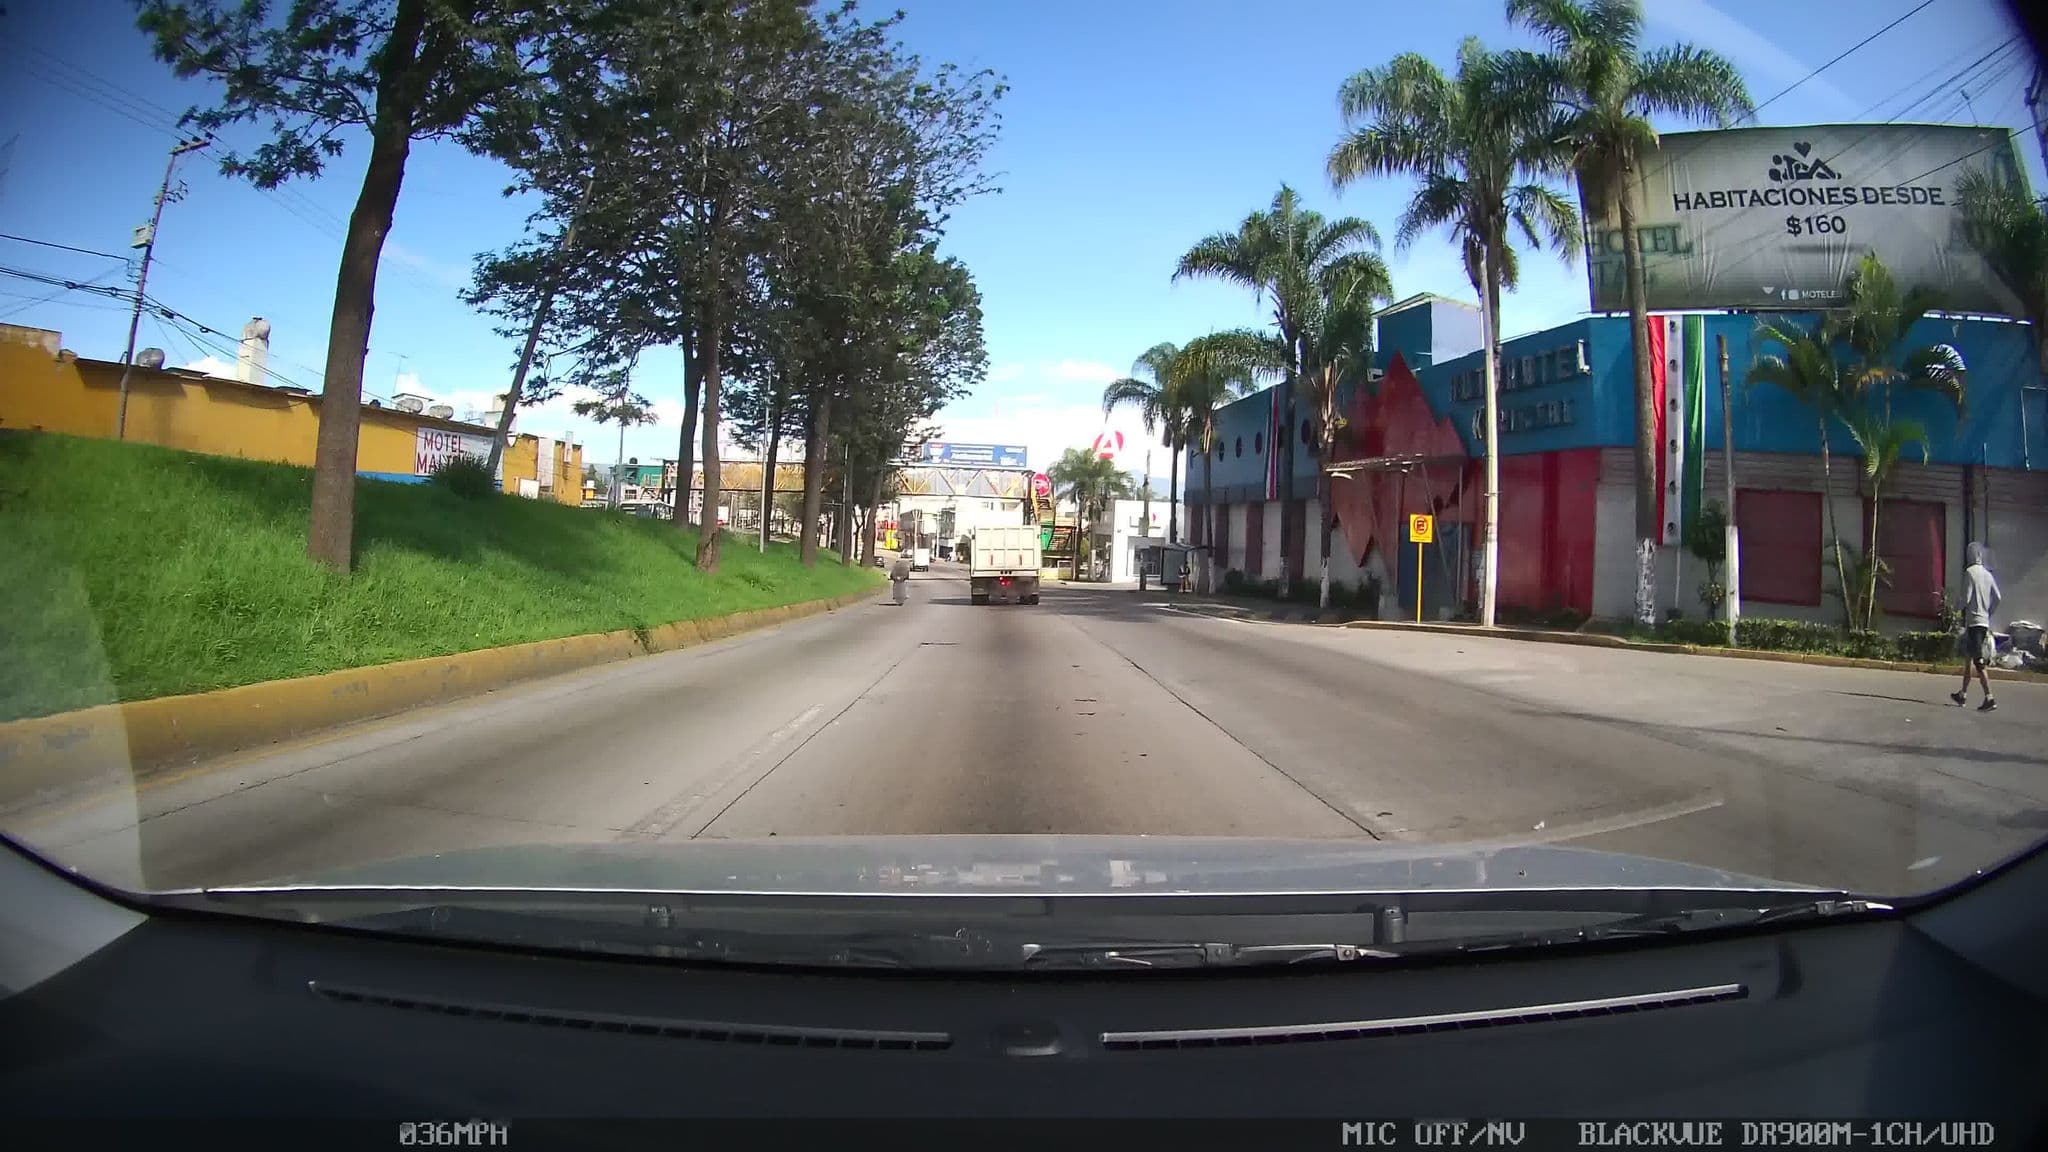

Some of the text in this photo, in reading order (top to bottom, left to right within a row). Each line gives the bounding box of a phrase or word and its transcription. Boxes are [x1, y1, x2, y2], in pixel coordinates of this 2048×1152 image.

[1673, 186, 1945, 211] HABITACIONES DESDE
[1786, 214, 1847, 237] $160
[424, 431, 464, 454] MOTEL
